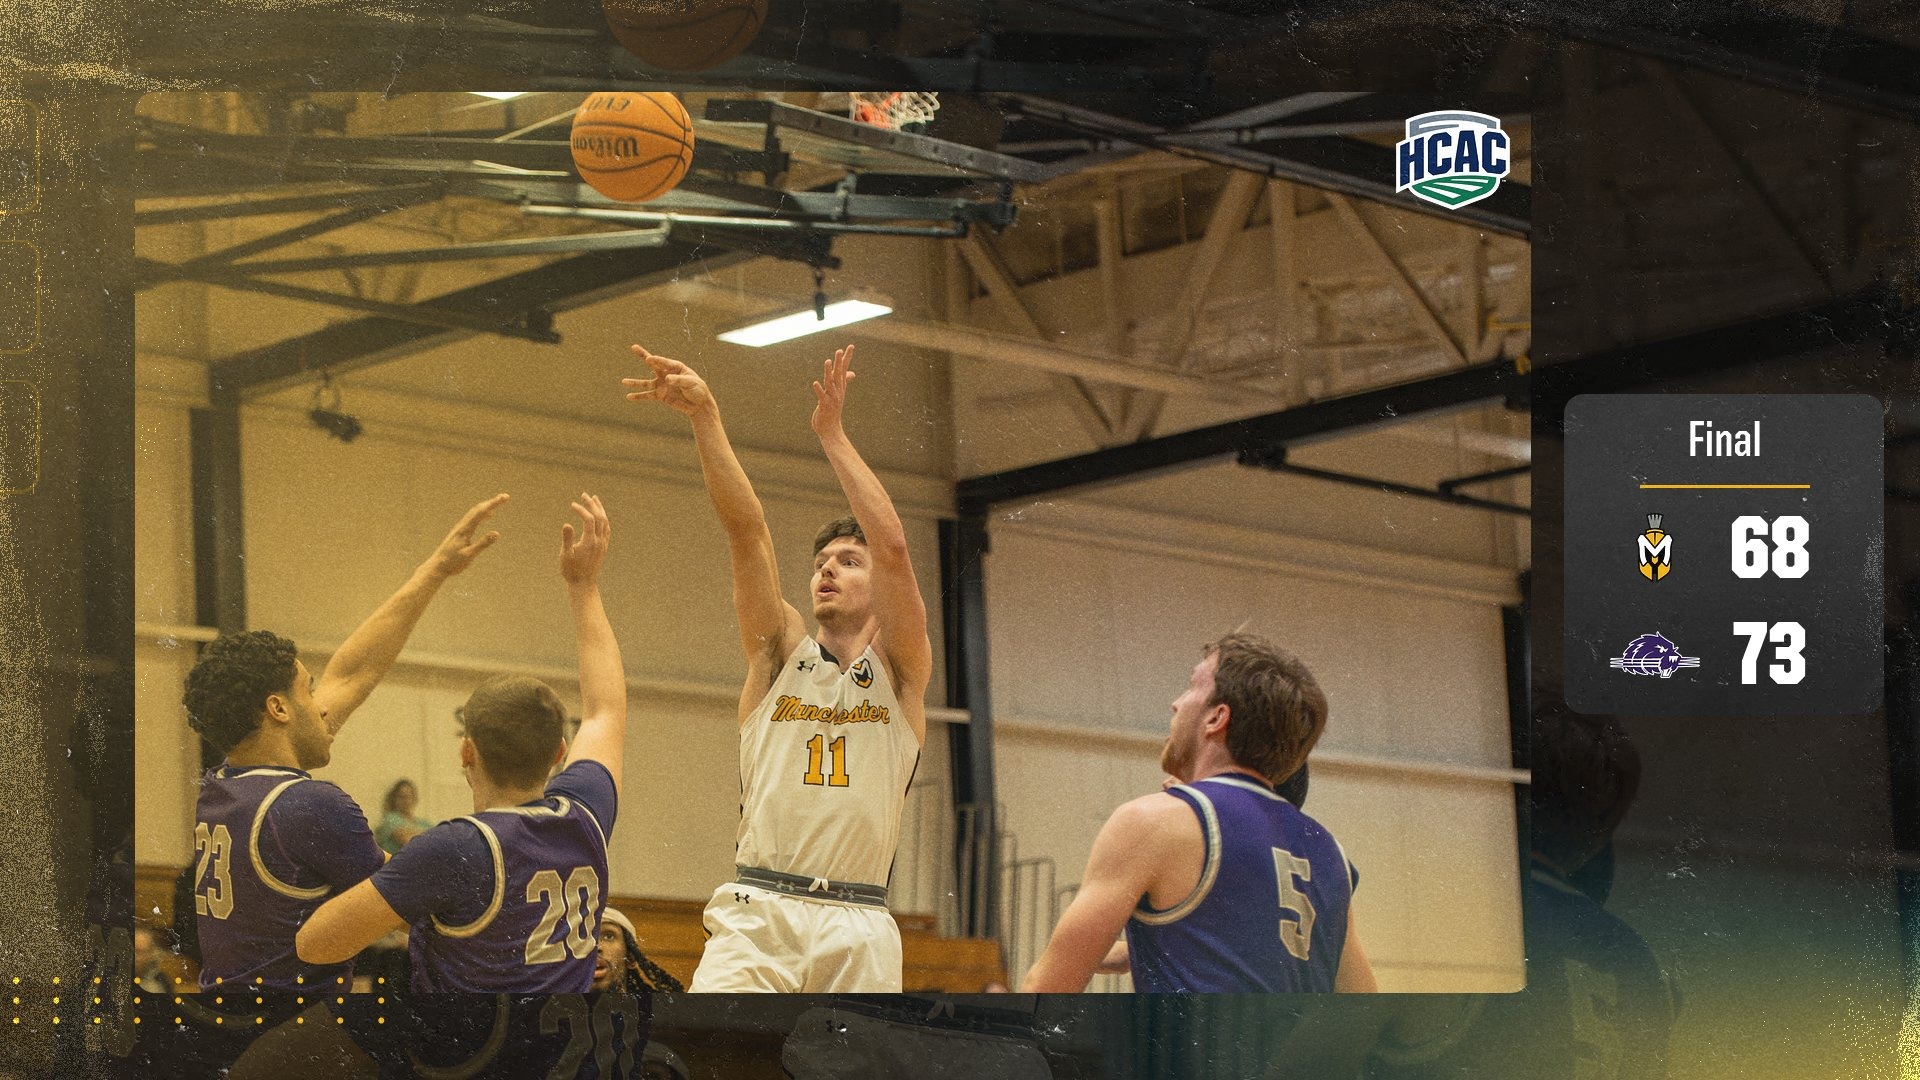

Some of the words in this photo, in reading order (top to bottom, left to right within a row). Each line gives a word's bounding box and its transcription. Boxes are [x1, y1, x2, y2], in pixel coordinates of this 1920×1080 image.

[803, 734, 849, 787] 11
[195, 822, 234, 920] 23
[525, 866, 600, 965] 20
[1271, 846, 1316, 962] 5
